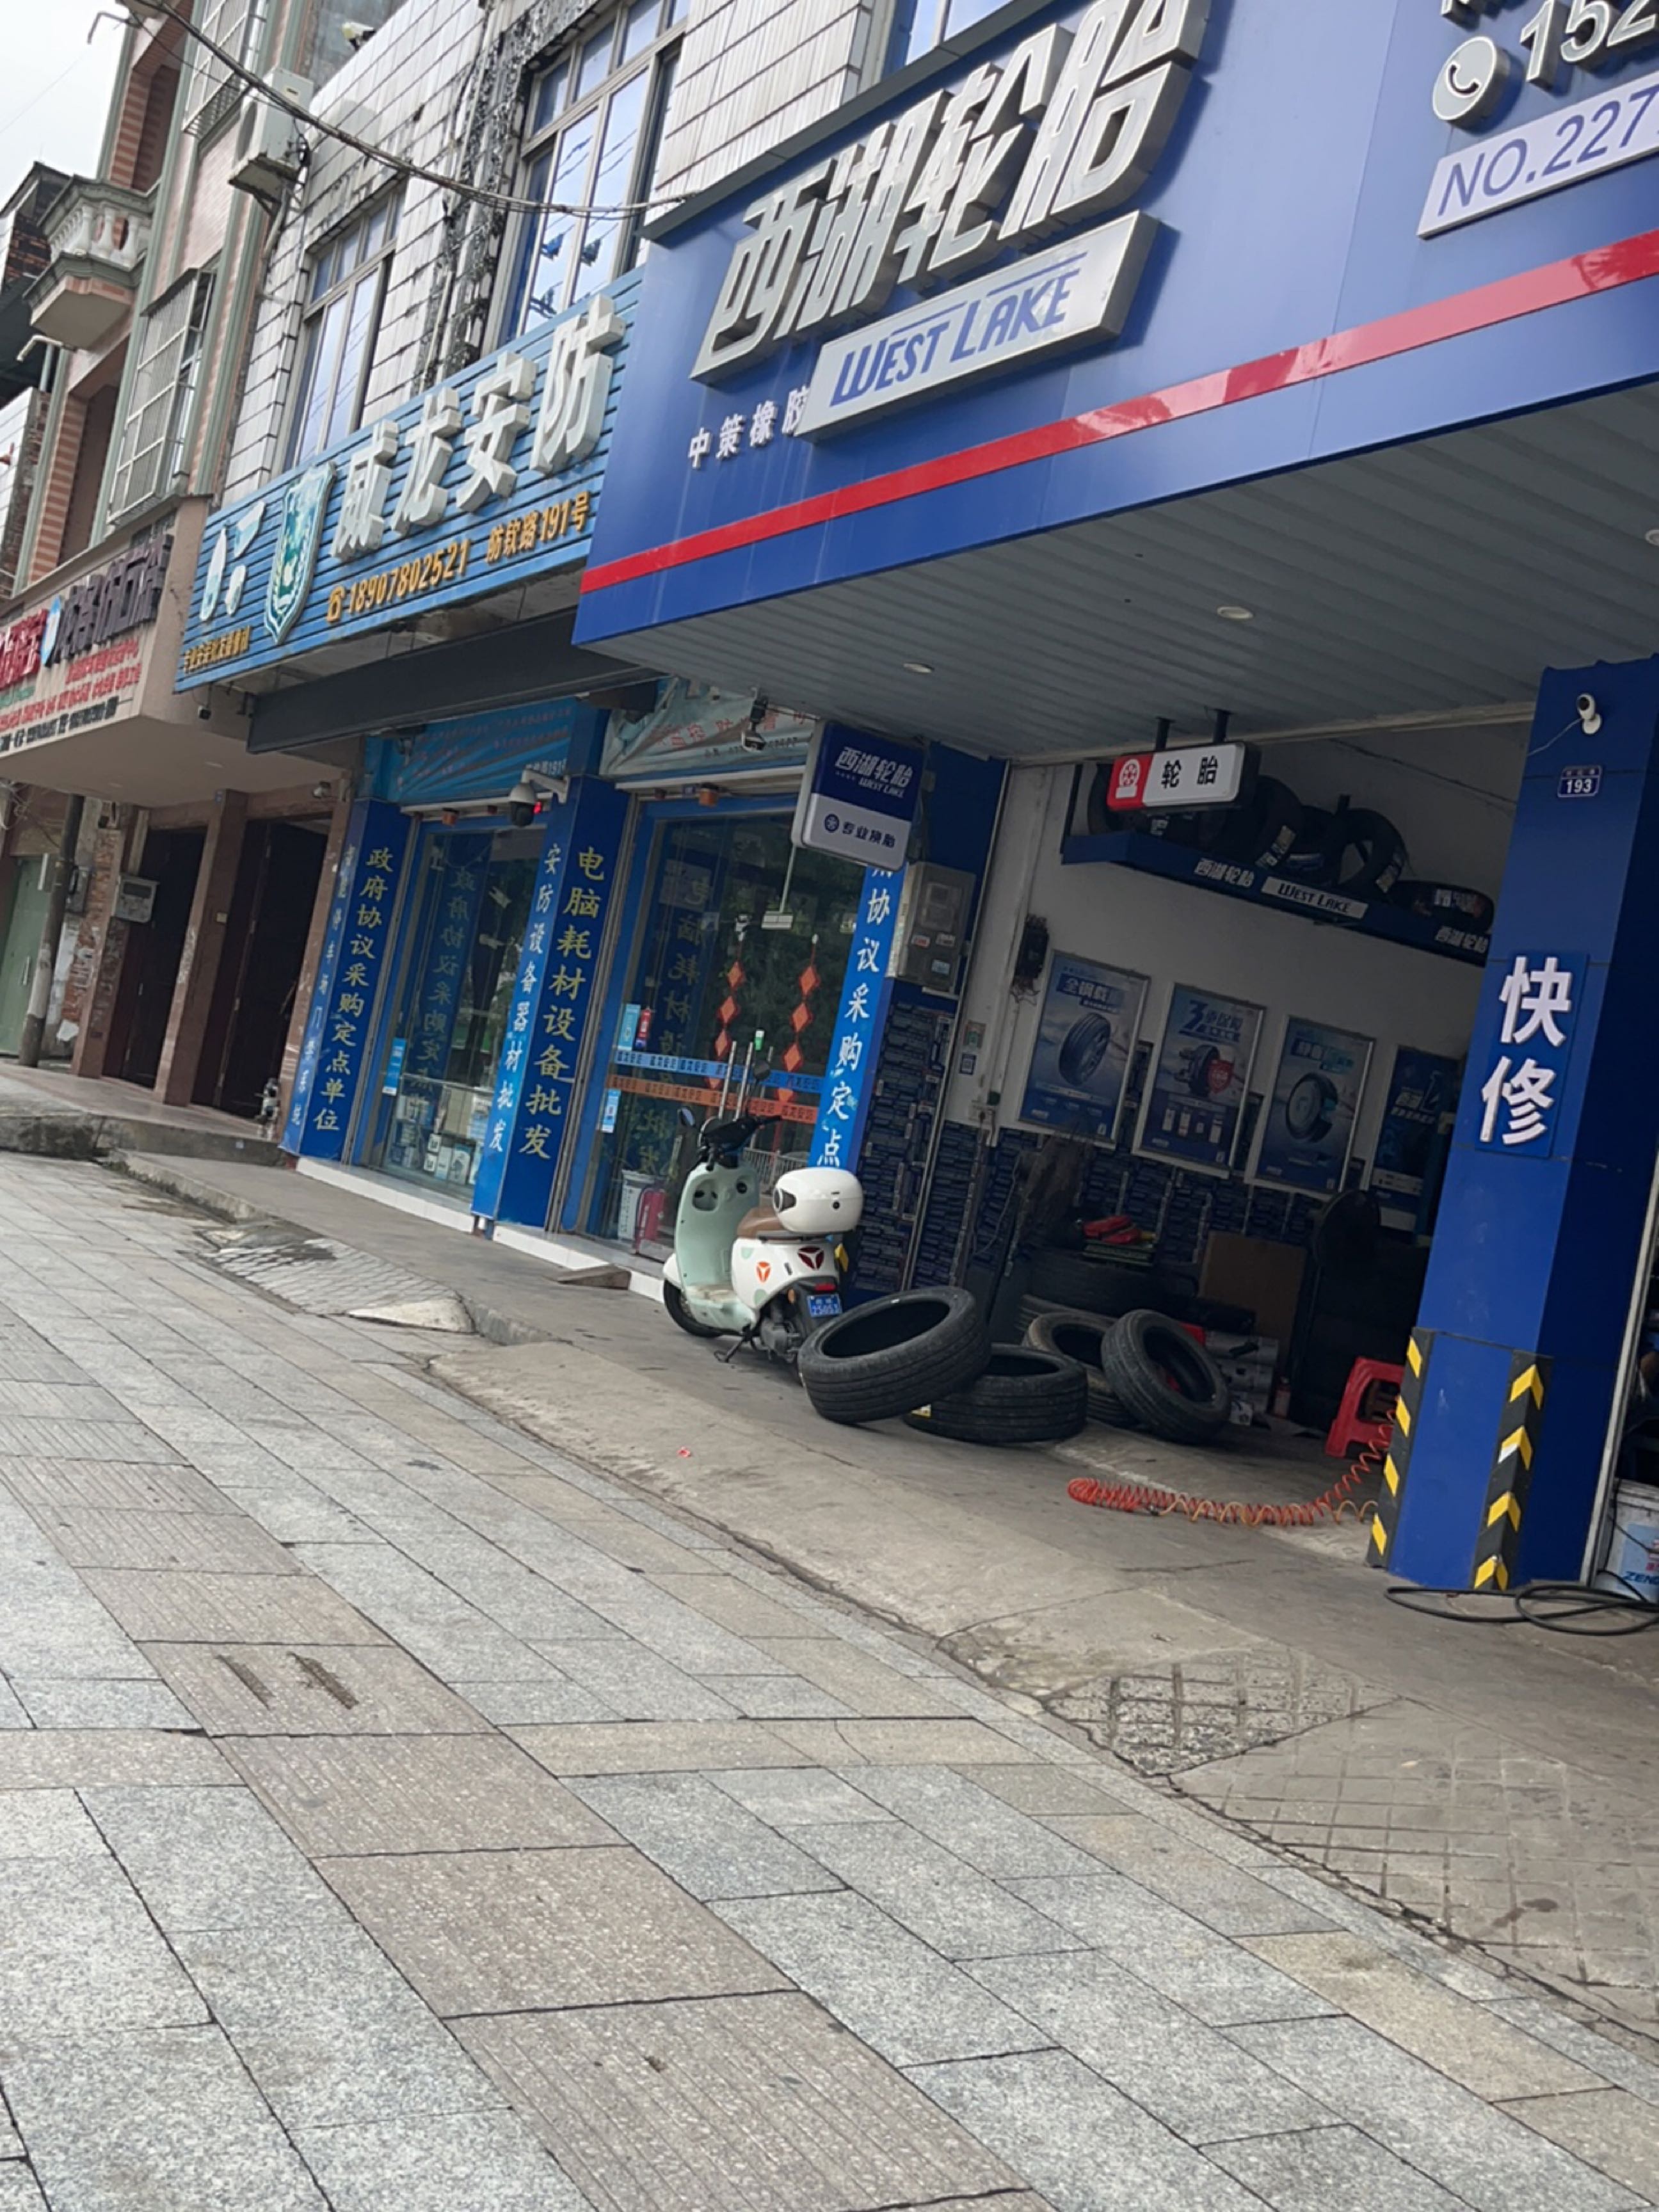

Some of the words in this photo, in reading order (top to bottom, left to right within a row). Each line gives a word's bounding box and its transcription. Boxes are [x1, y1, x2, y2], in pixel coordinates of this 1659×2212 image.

[691, 0, 1205, 380] 西湖轮胎
[1438, 85, 1659, 216] NO.227
[831, 319, 953, 406] WEST
[950, 269, 1079, 362] LAKE
[331, 294, 627, 562] 威龙安防
[349, 539, 471, 613] 18907802521
[835, 746, 913, 788] 西湖轮胎
[1160, 755, 1219, 789] 轮胎
[1566, 778, 1592, 794] 193
[1194, 858, 1254, 888] 西湖轮胎
[1278, 882, 1315, 902] WEST
[1317, 894, 1351, 913] LAKE
[314, 847, 392, 1132] 政府协议采购定点单位
[488, 843, 563, 1153] 安防设备器材批发
[519, 847, 604, 1160] 电脑耗材设备批发
[1434, 926, 1488, 954] 西湖轮胎
[1480, 956, 1572, 1145] 快修
